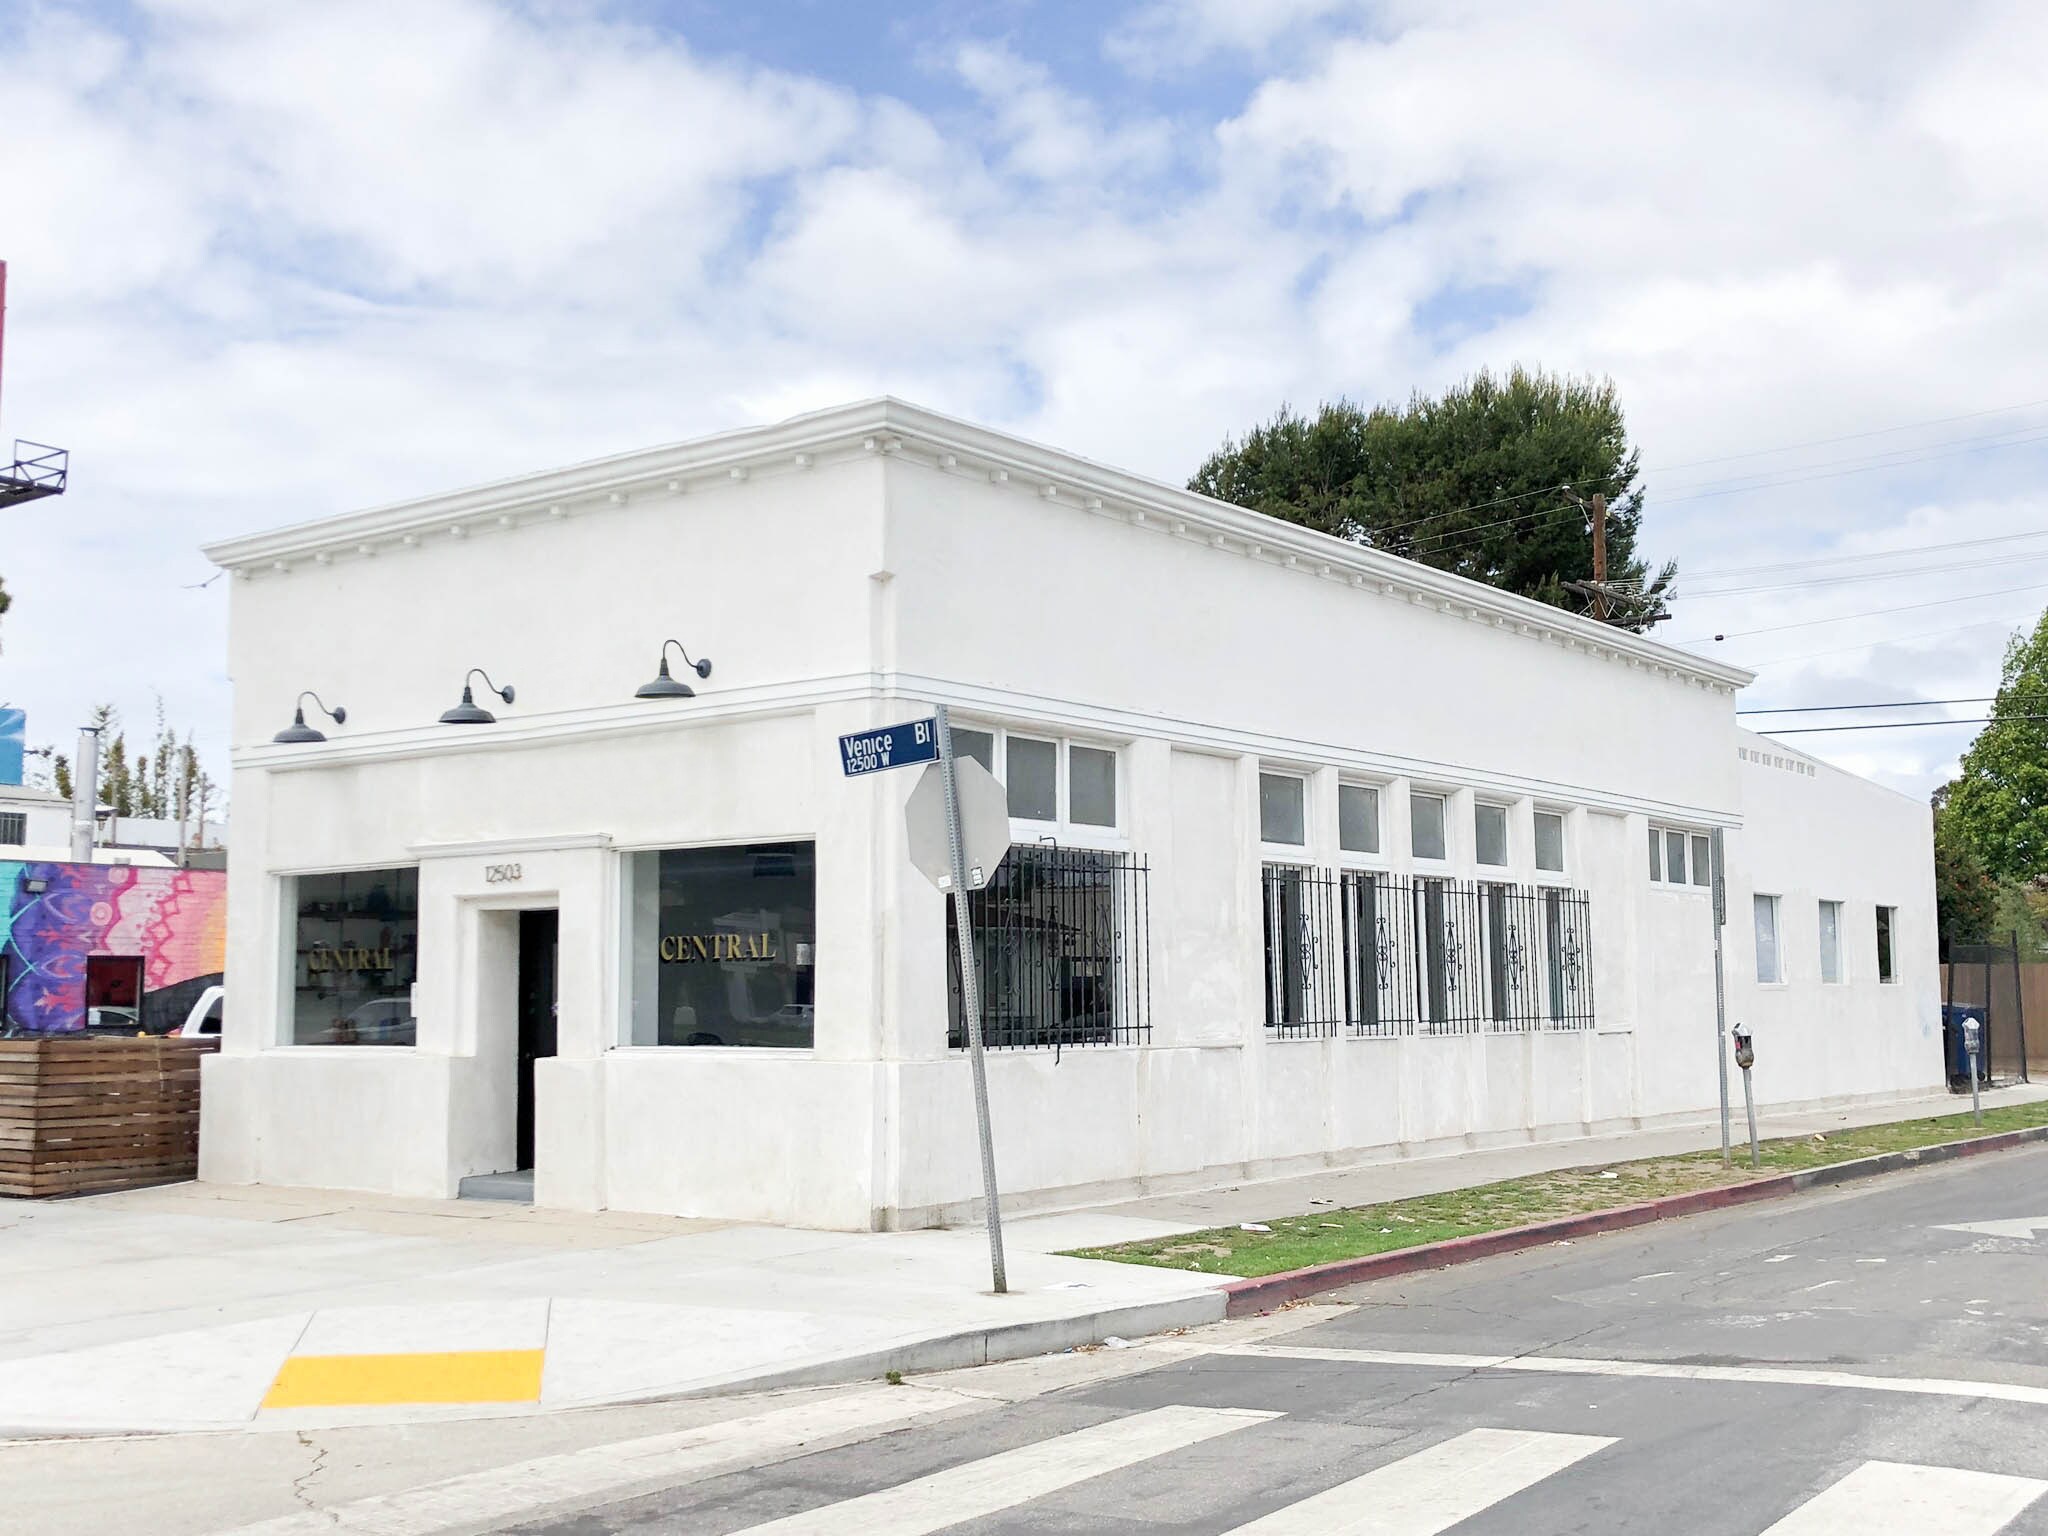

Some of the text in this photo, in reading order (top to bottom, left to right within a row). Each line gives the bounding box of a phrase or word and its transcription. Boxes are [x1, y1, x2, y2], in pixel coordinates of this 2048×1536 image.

[844, 722, 930, 758] Venice Bl
[846, 752, 890, 773] 12500 W
[485, 863, 522, 883] 12503
[660, 933, 776, 962] CENTRAL
[308, 949, 394, 970] CENTRAL
